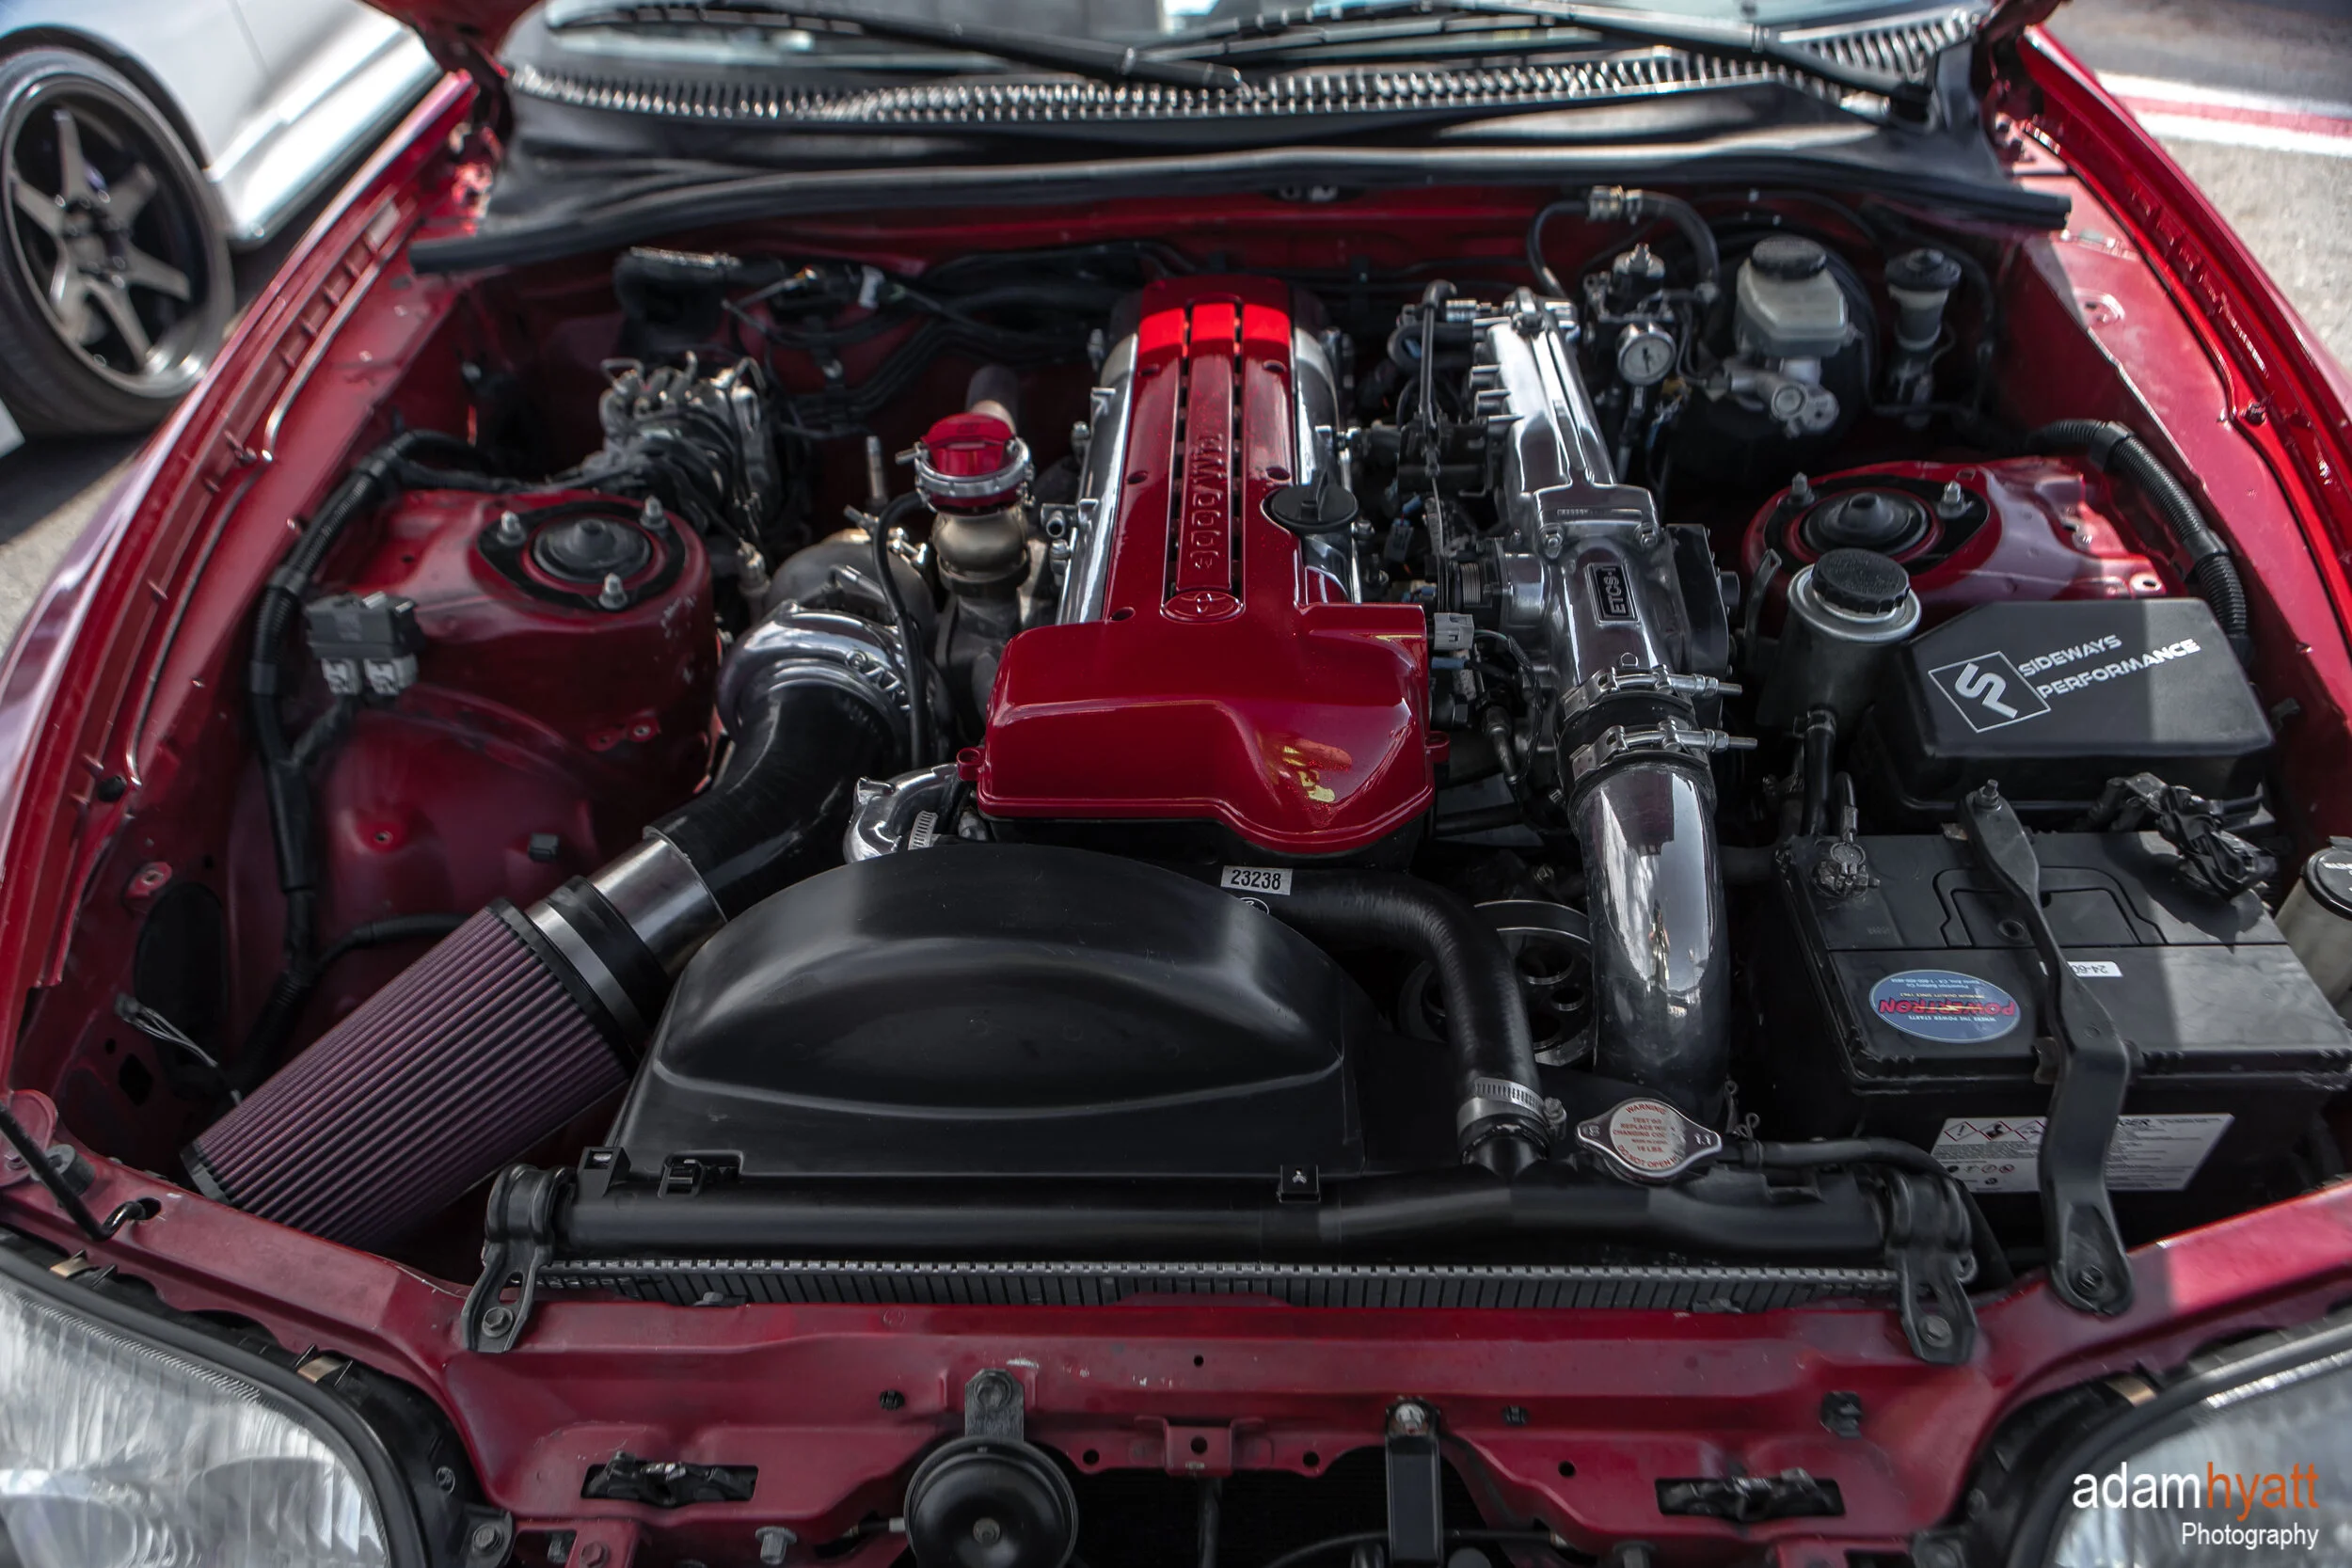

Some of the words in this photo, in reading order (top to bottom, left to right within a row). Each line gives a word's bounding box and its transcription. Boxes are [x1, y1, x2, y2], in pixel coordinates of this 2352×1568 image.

[2018, 634, 2122, 677] SIDEWAYS
[2036, 638, 2201, 699] PERFORMANCE
[1231, 869, 1281, 890] 23238
[1878, 998, 2015, 1016] POWERTRON
[1626, 1103, 1666, 1115] WARNING
